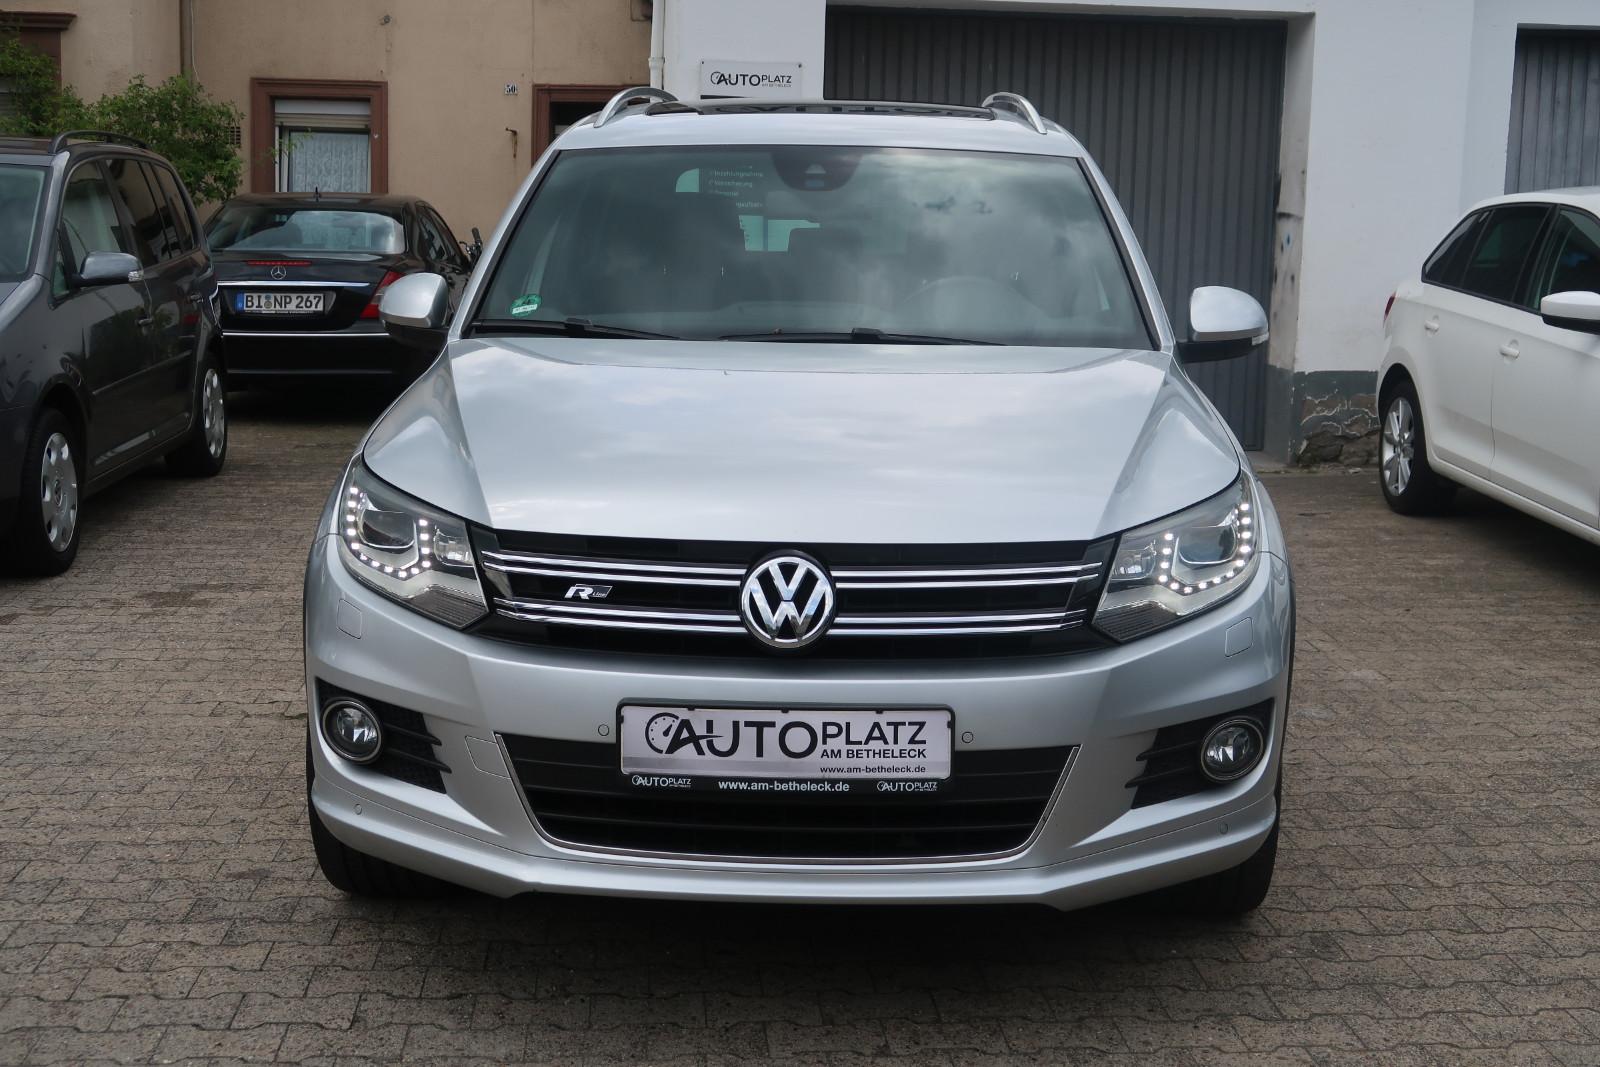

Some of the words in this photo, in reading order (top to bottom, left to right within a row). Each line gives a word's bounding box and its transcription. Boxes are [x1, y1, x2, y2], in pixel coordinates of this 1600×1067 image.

[505, 84, 516, 94] 50
[245, 294, 263, 309] BI
[273, 294, 293, 309] NP
[295, 295, 322, 309] 267
[820, 749, 842, 759] AM
[846, 748, 927, 759] BETHELECK
[820, 765, 926, 773] www.am-betheleck.de
[718, 779, 850, 792] www.am-betheleck.de
